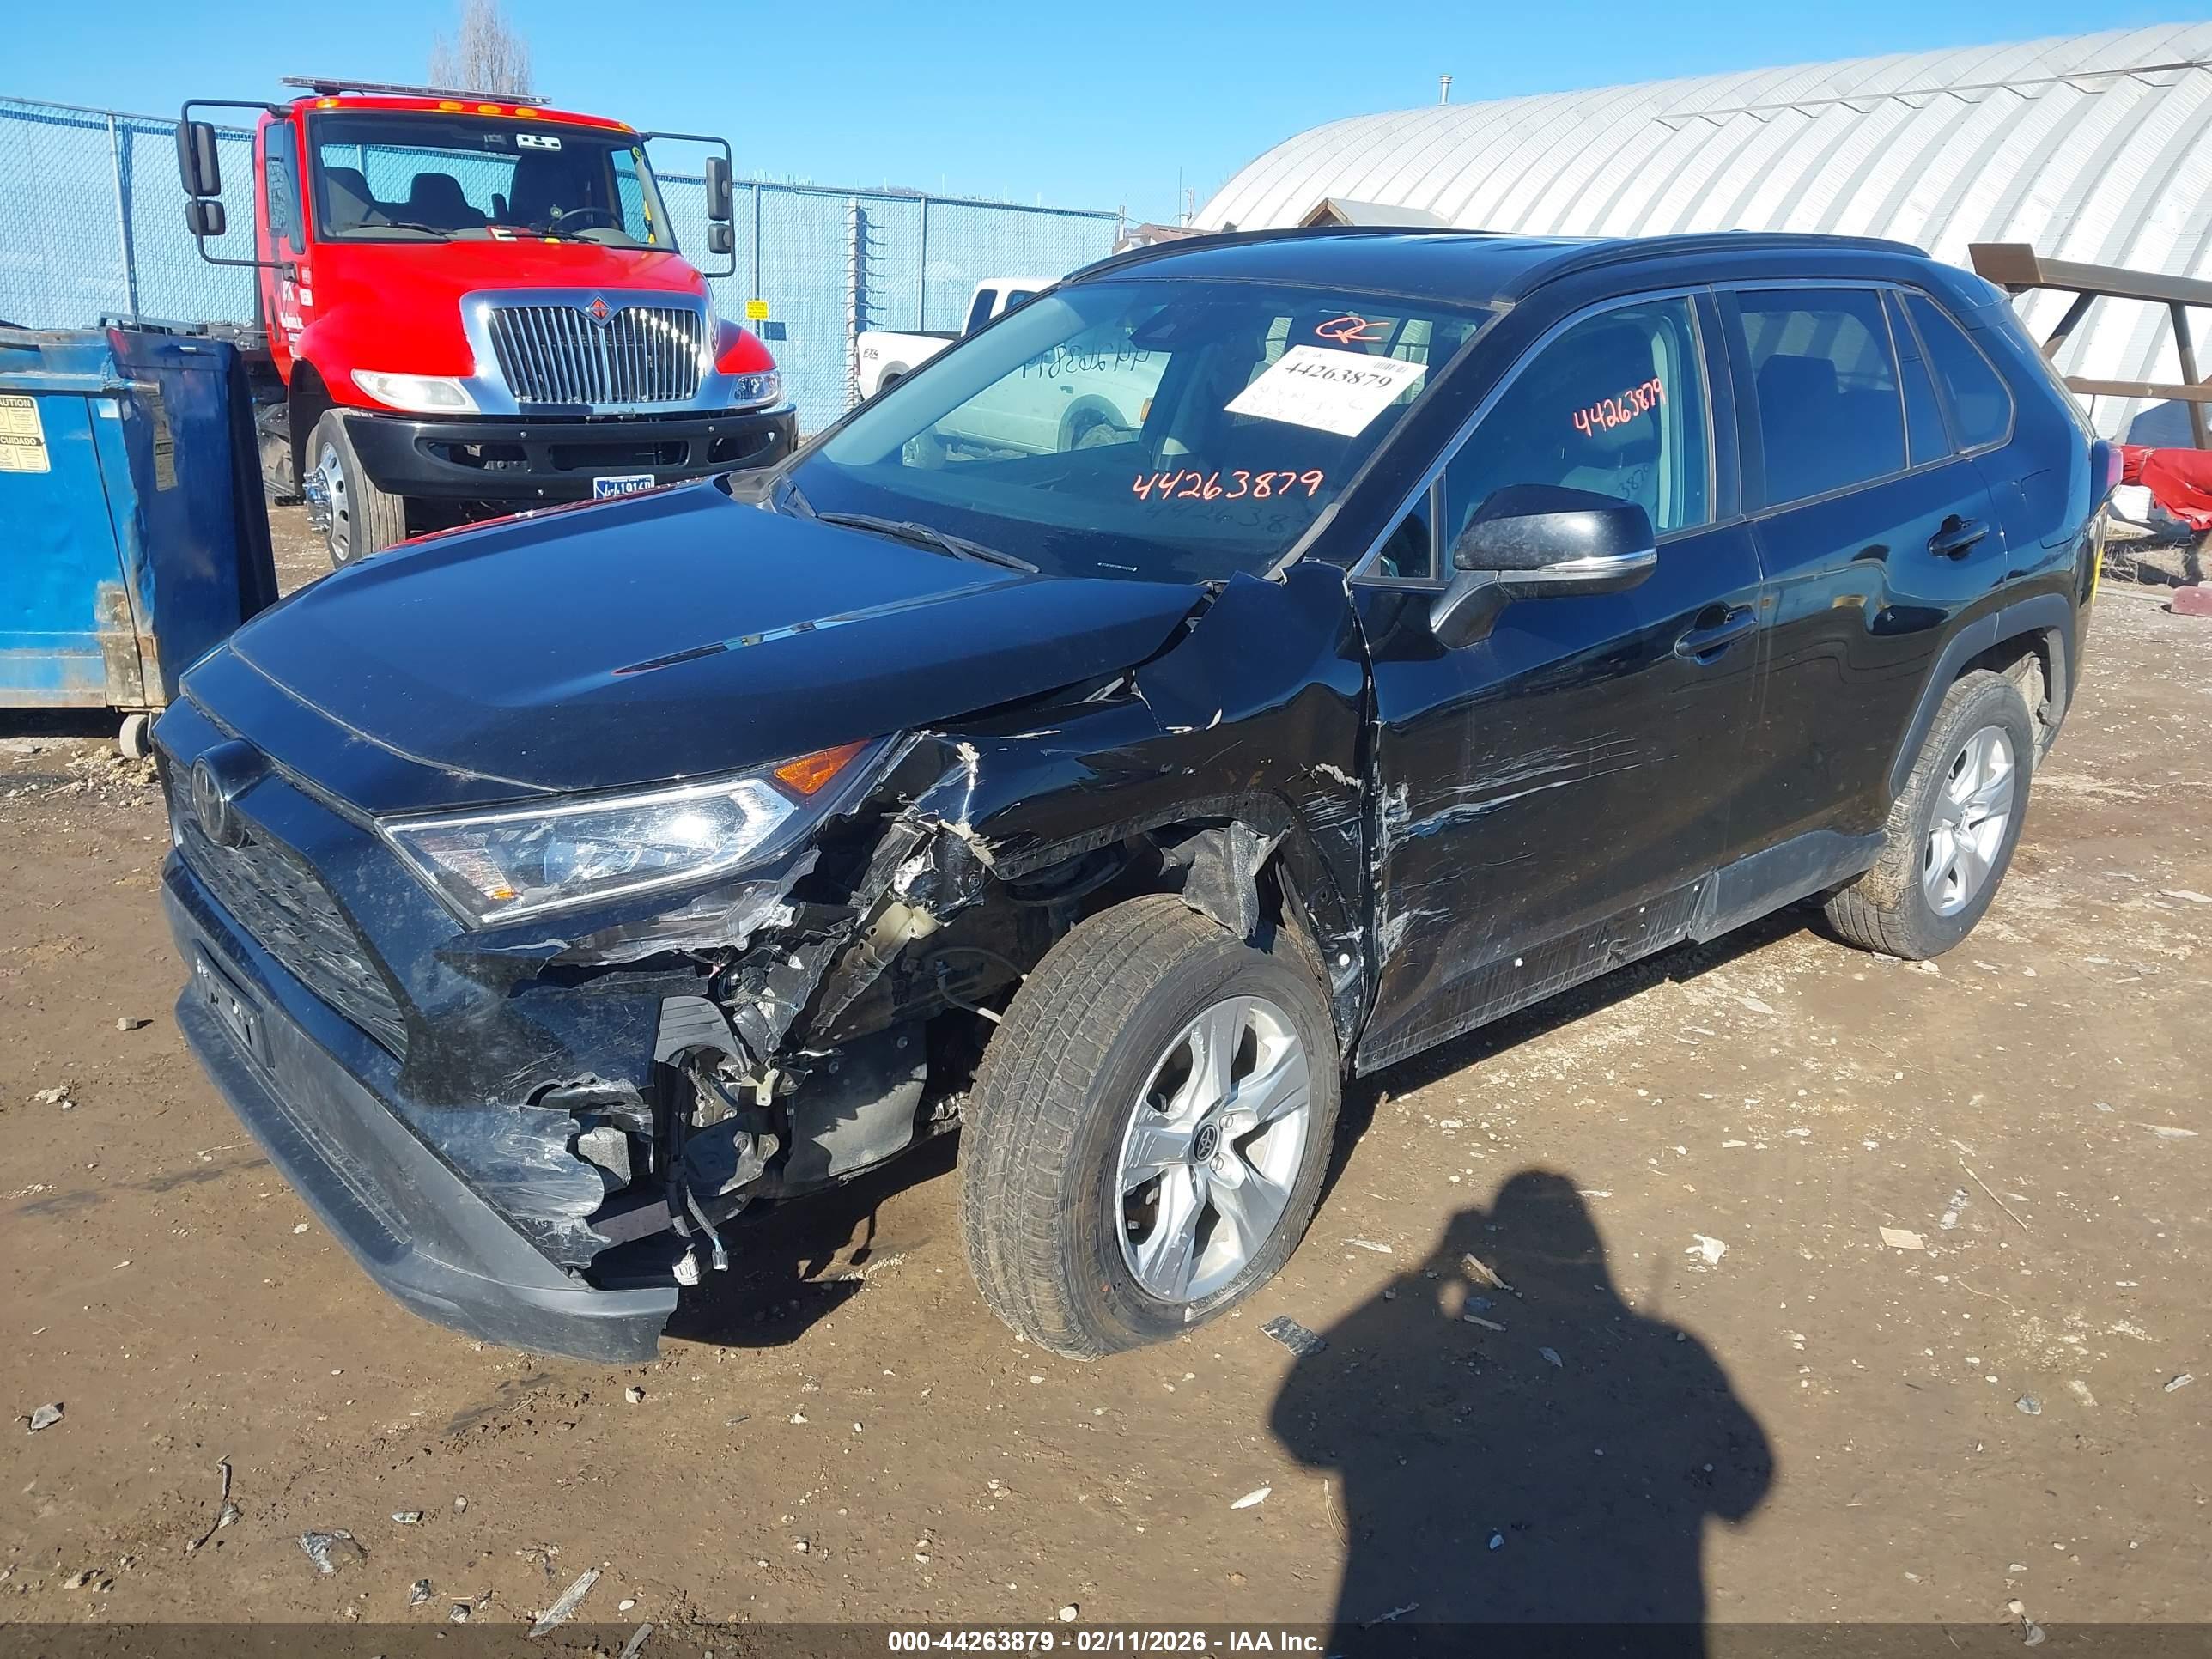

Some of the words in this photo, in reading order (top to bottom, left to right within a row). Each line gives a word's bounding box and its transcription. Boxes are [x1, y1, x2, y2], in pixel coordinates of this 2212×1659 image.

[1285, 361, 1393, 389] 44263879
[1573, 377, 1667, 437] 44263879
[0, 435, 37, 446] CUIDADO
[1132, 469, 1325, 501] 44263879
